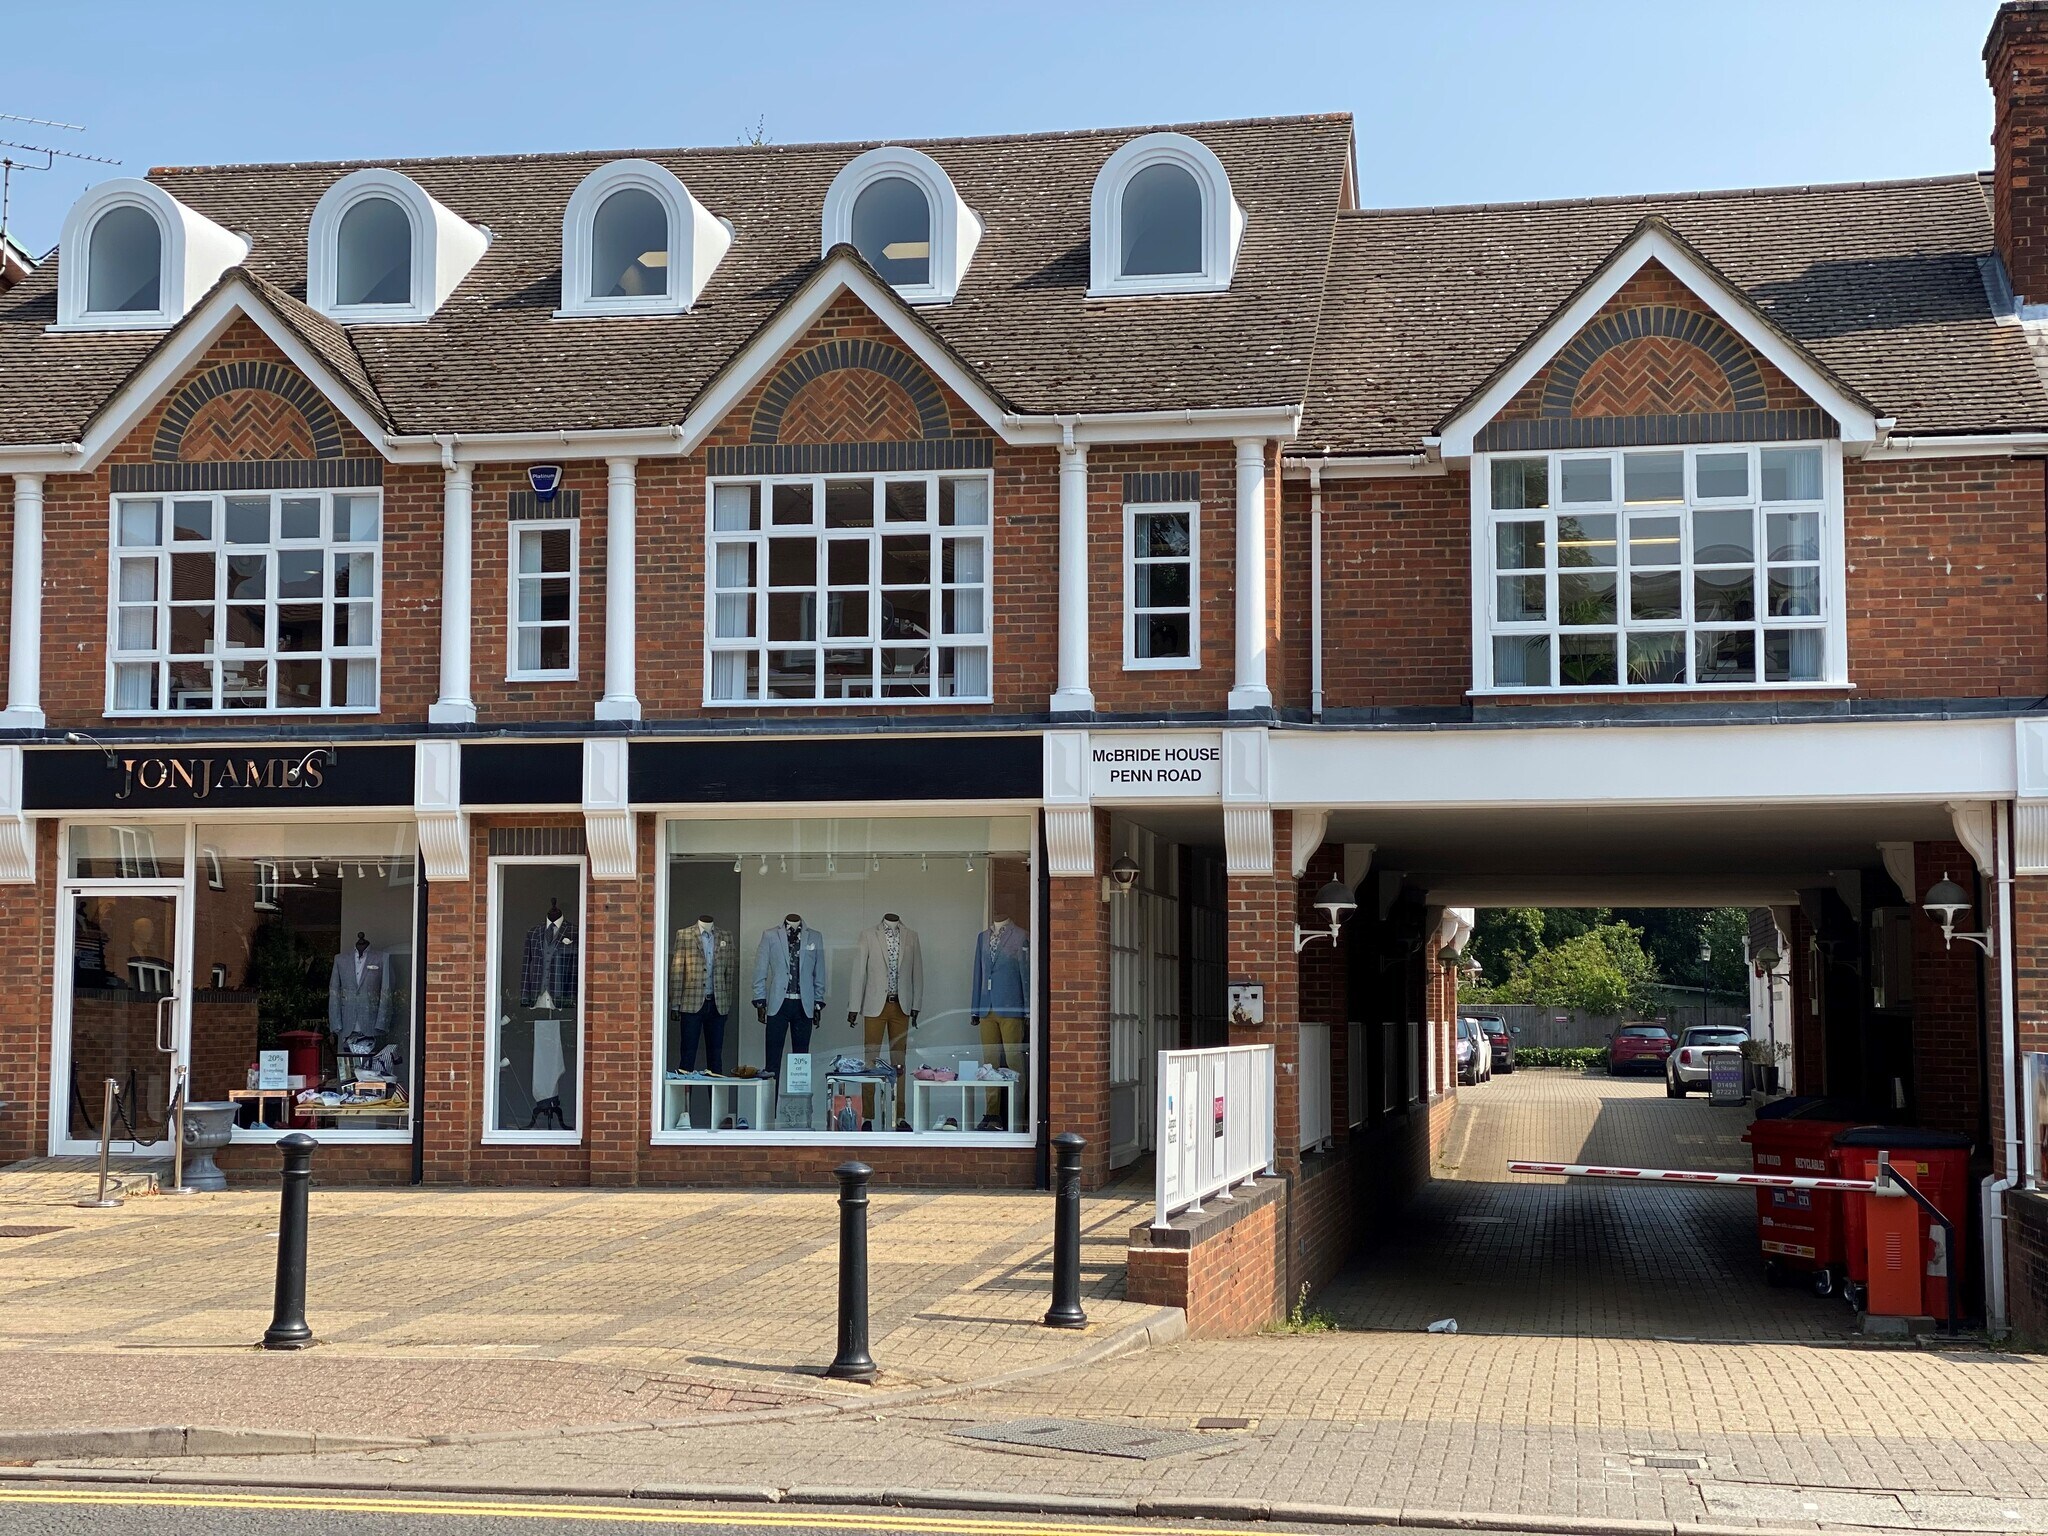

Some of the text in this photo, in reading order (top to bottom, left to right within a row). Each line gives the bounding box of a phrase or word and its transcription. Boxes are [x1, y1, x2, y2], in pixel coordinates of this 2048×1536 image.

[1092, 748, 1220, 762] McBRIDE HOUSE
[1110, 769, 1202, 782] PENN ROAD
[267, 1054, 284, 1062] 20%
[793, 1057, 808, 1065] 20%
[1795, 1157, 1826, 1171] RECYCLABLES
